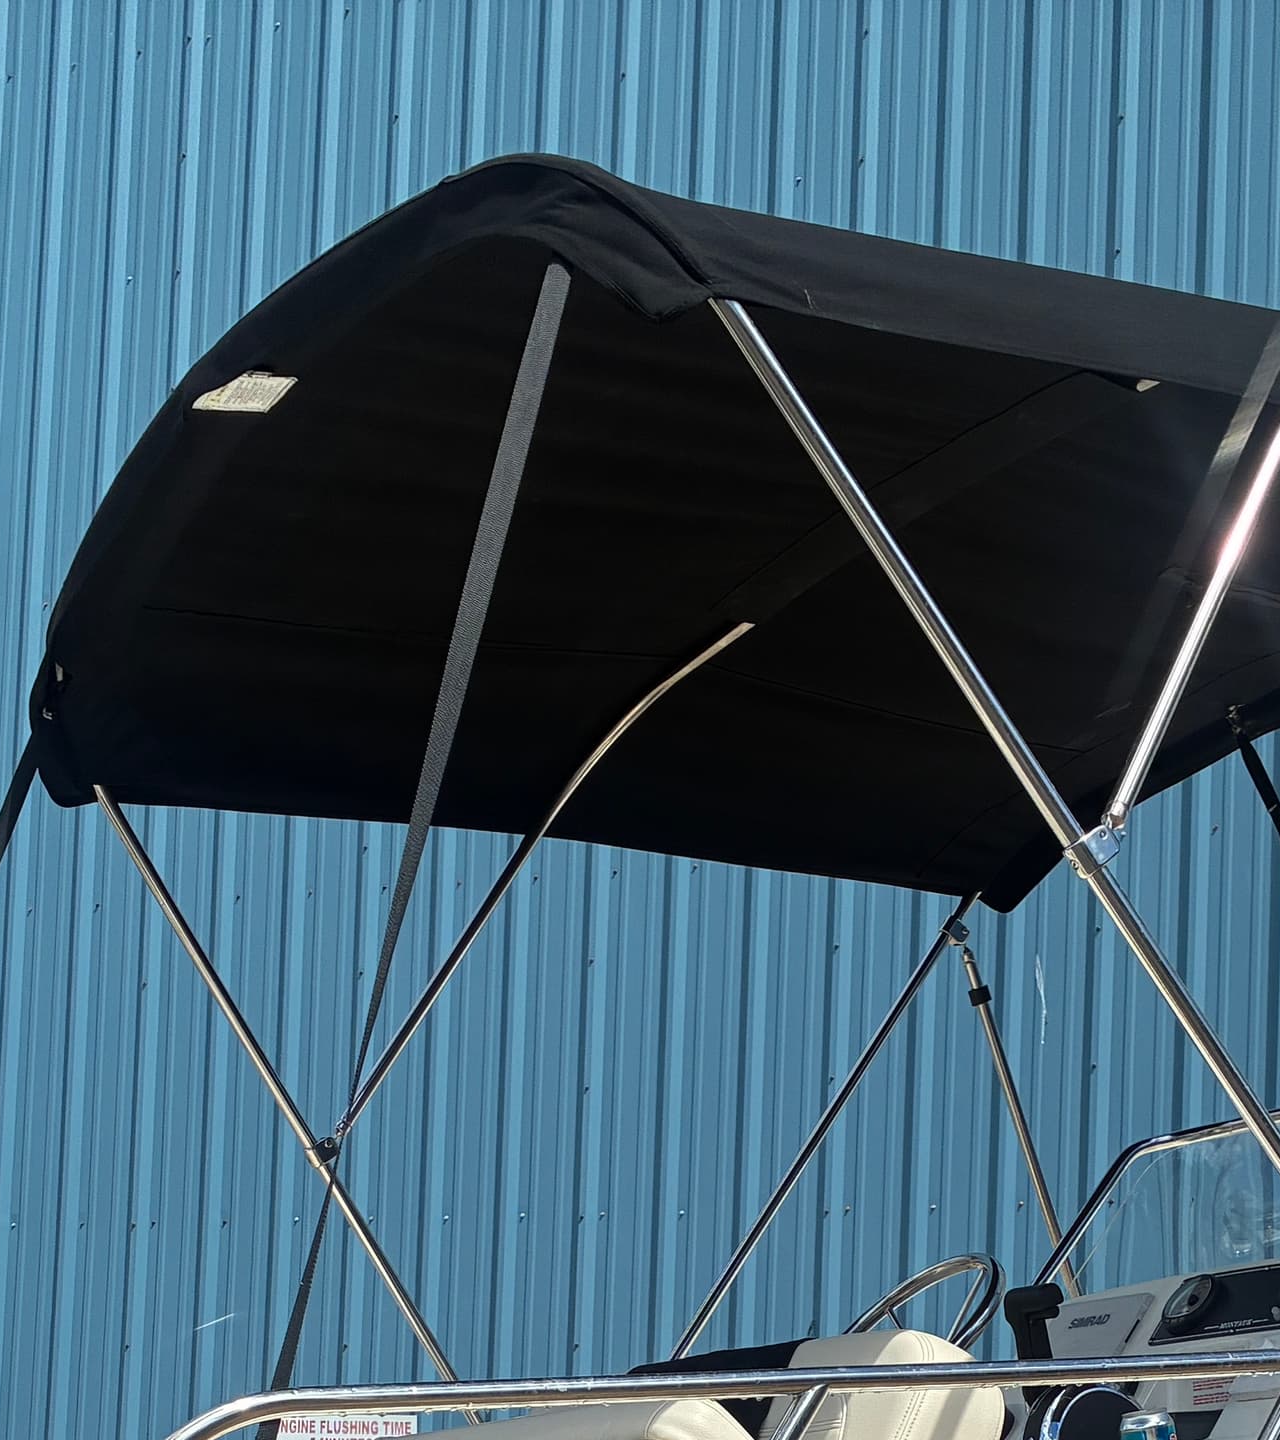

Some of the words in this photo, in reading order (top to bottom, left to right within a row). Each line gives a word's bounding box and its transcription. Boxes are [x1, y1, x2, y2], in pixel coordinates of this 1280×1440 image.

[280, 1419, 316, 1434] NGINE
[320, 1420, 379, 1435] FLUSHING
[383, 1421, 412, 1435] TIME
